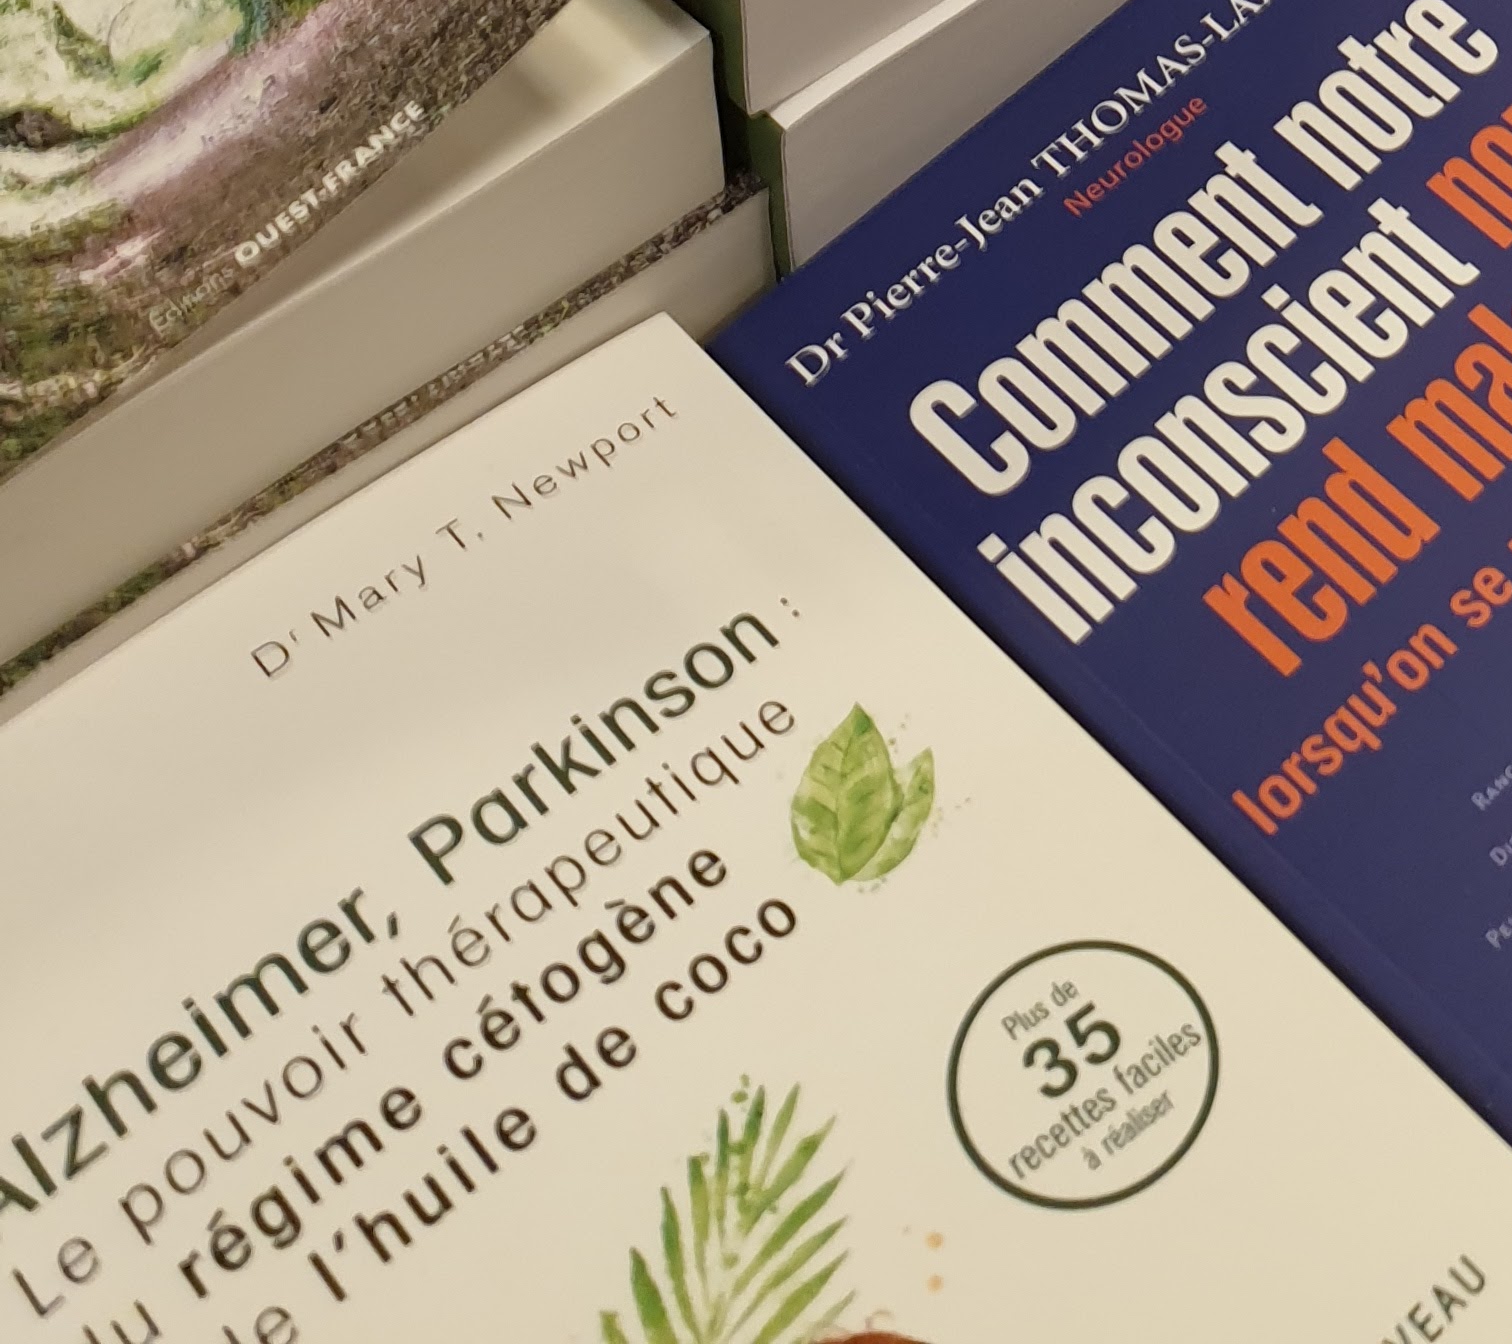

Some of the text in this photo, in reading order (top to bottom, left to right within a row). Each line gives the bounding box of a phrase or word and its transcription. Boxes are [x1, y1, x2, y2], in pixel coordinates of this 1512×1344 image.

[232, 97, 428, 271] OUEST-FRANCE
[1060, 94, 1209, 219] Neurologue
[784, 330, 852, 389] Dr
[839, 173, 1046, 342] Pierre-Jean
[908, 138, 1326, 498] Comment
[249, 394, 680, 679] Dr Mary Newport
[975, 194, 1482, 647] inconscient
[1200, 435, 1441, 680] rend
[405, 608, 780, 888] Parkinson
[1229, 619, 1460, 838] lorsqu'on
[11, 696, 798, 1322] Le pouvoir thérapeutique
[176, 846, 731, 1302] régime cétogène
[306, 895, 799, 1304] l'huile de coco
[1000, 1000, 1051, 1042] Plus
[1007, 1022, 1202, 1181] recettes faciles
[1022, 999, 1122, 1100] 35
[1100, 1088, 1176, 1157] réaliser
